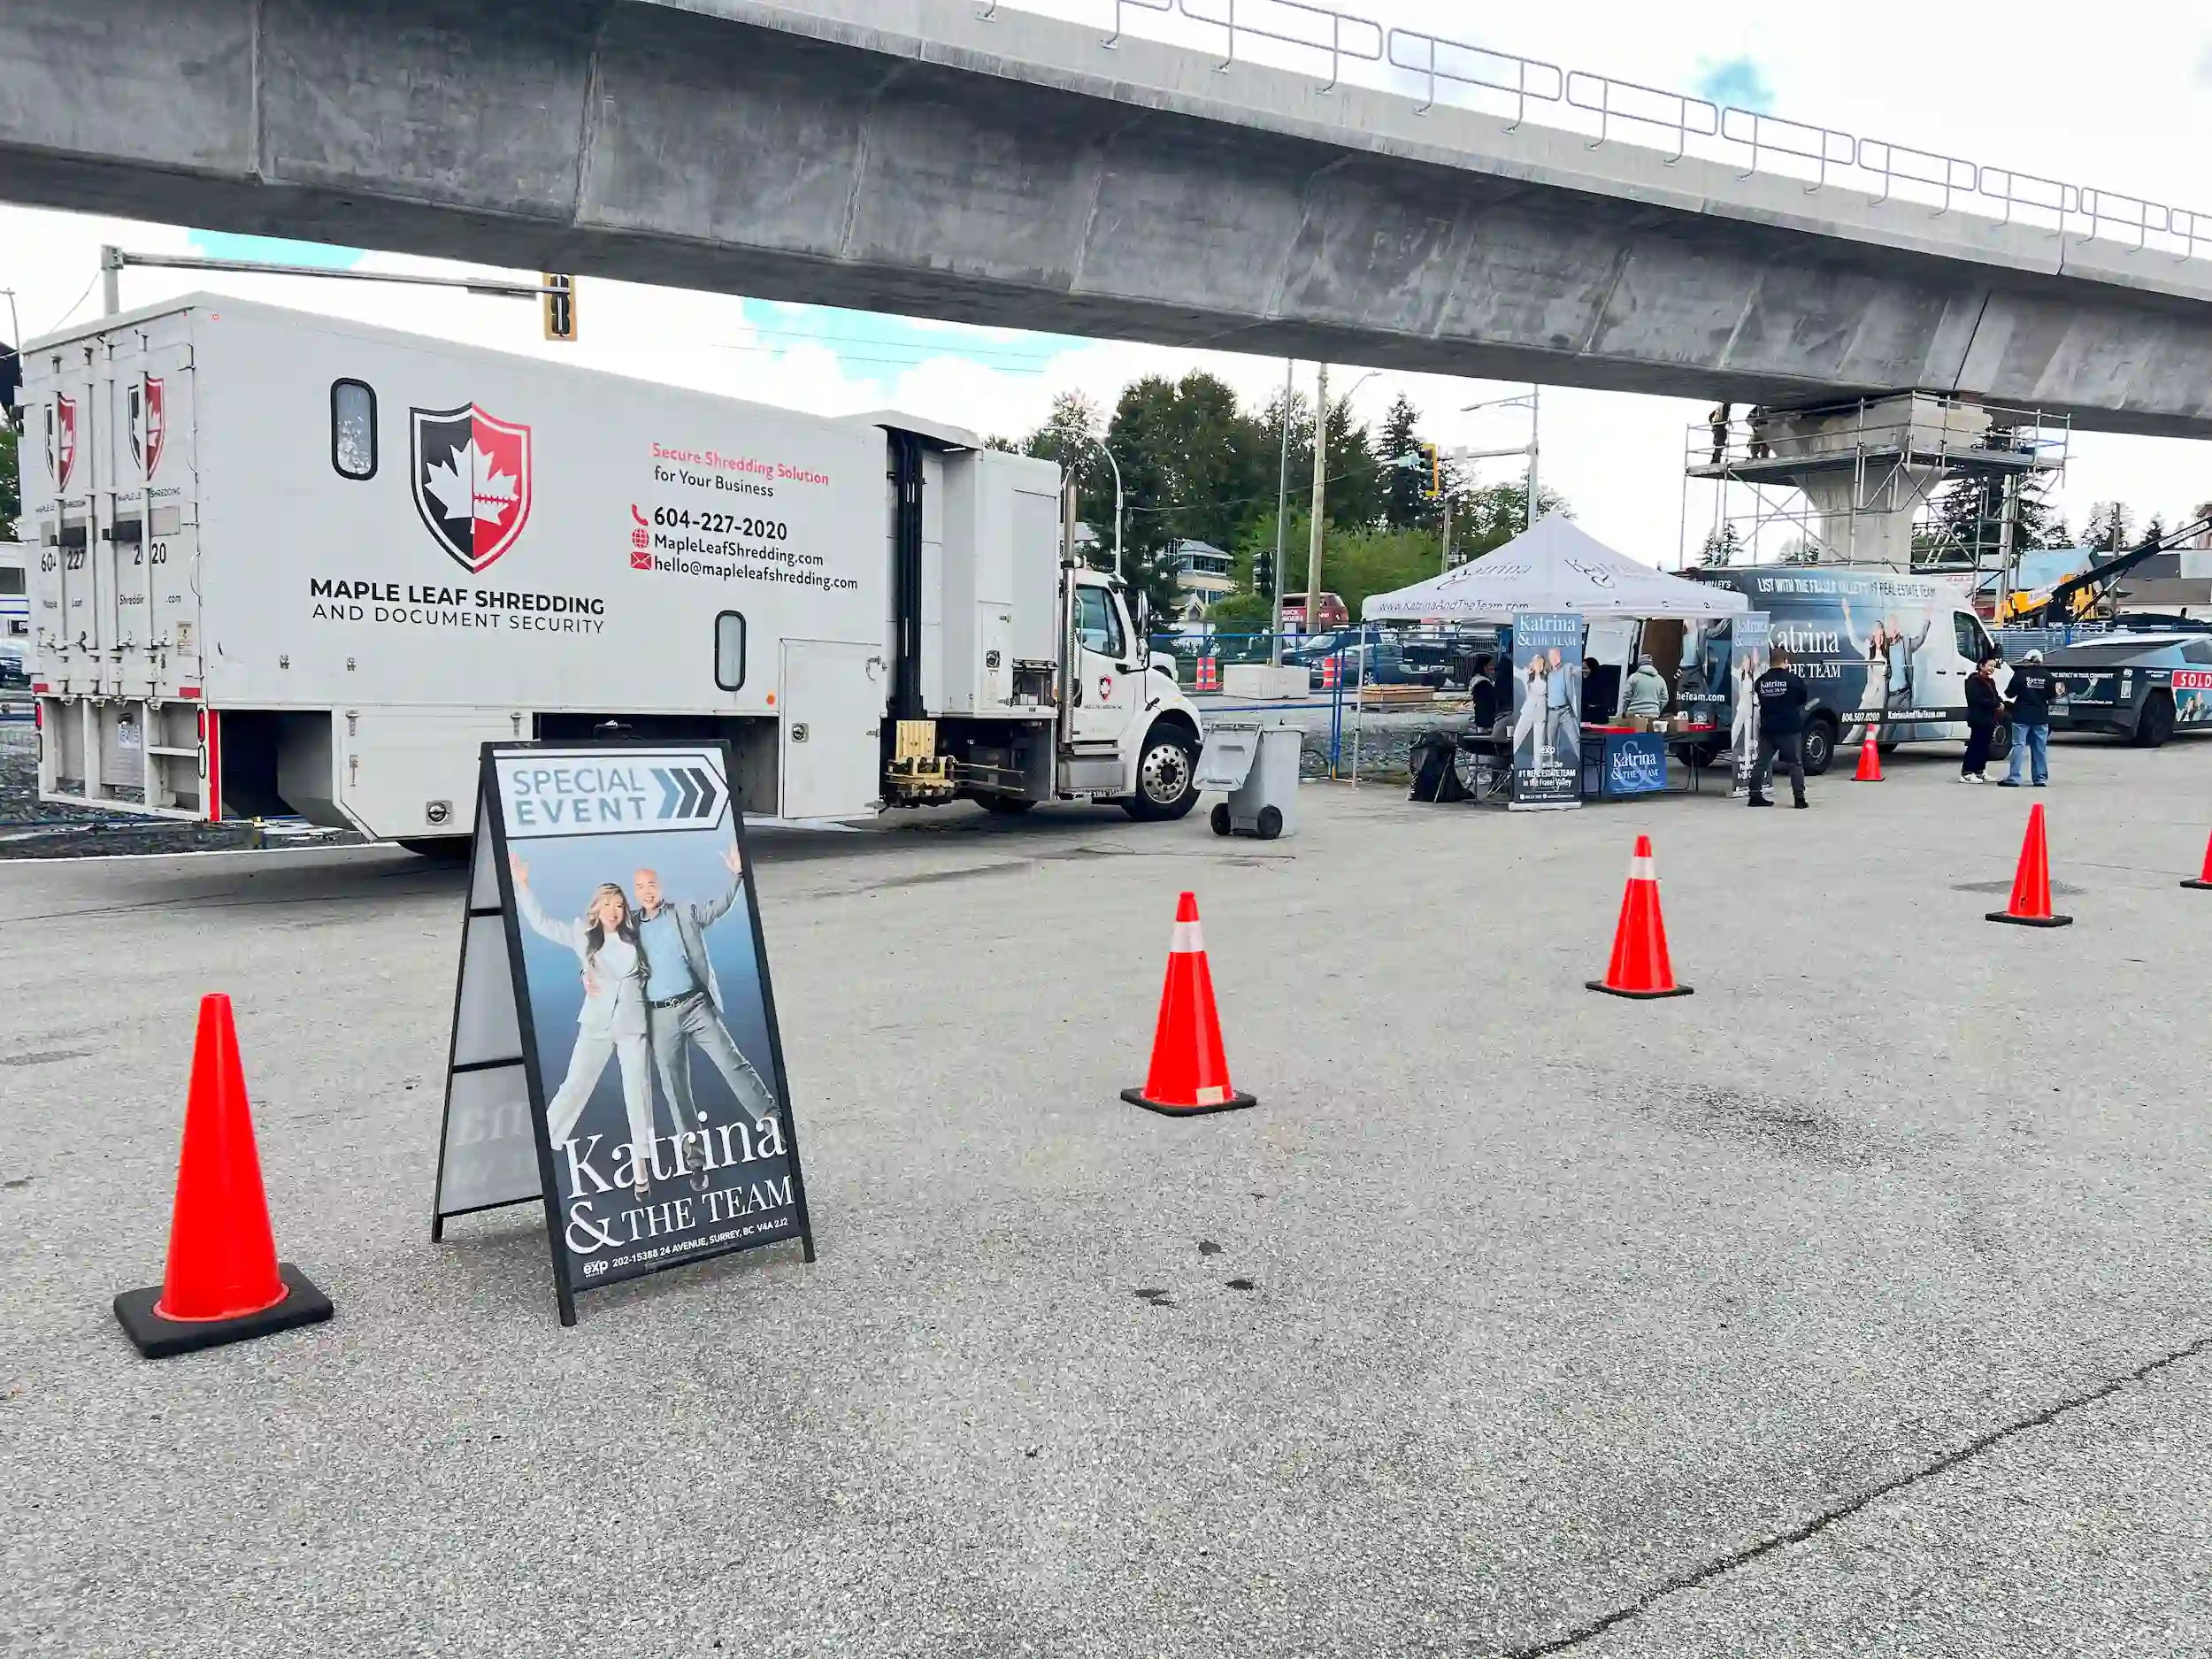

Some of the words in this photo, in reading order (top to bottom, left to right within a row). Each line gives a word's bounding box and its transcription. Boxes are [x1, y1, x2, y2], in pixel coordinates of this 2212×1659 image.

[652, 442, 702, 464] Secure
[705, 451, 774, 480] Shredding
[778, 464, 829, 485] Solution
[655, 465, 676, 482] for
[680, 469, 711, 488] Your
[715, 475, 774, 496] Business
[654, 506, 787, 541] 604-227-2020
[655, 534, 824, 567] MapleLeafShredding.com
[655, 555, 857, 590] hello@mapleleafshredding.com
[1757, 578, 1774, 592] LIST
[311, 578, 400, 602] MAPLE
[408, 585, 467, 606] LEAF
[475, 590, 604, 615] SHREDDING
[312, 603, 364, 620] AND
[376, 607, 501, 628] DOCUMENT
[510, 615, 603, 634] SECURITY
[1519, 615, 1576, 632] Katrina
[1517, 632, 1532, 646] &
[1806, 664, 1841, 679] TEAM
[2181, 673, 2212, 687] SOLD
[1613, 750, 1656, 767] Katrina
[513, 767, 646, 795] SPECIAL
[515, 797, 647, 825] EVENT
[563, 1110, 788, 1200] Katrina
[565, 1200, 626, 1255] &
[621, 1197, 696, 1242] THE
[702, 1174, 795, 1224] TEAM
[612, 1249, 658, 1267] 202-15388
[659, 1246, 672, 1256] 24
[709, 1229, 742, 1245] SURREY,
[742, 1226, 755, 1236] BC
[757, 1222, 774, 1233] V4A
[774, 1217, 789, 1228] 2J2
